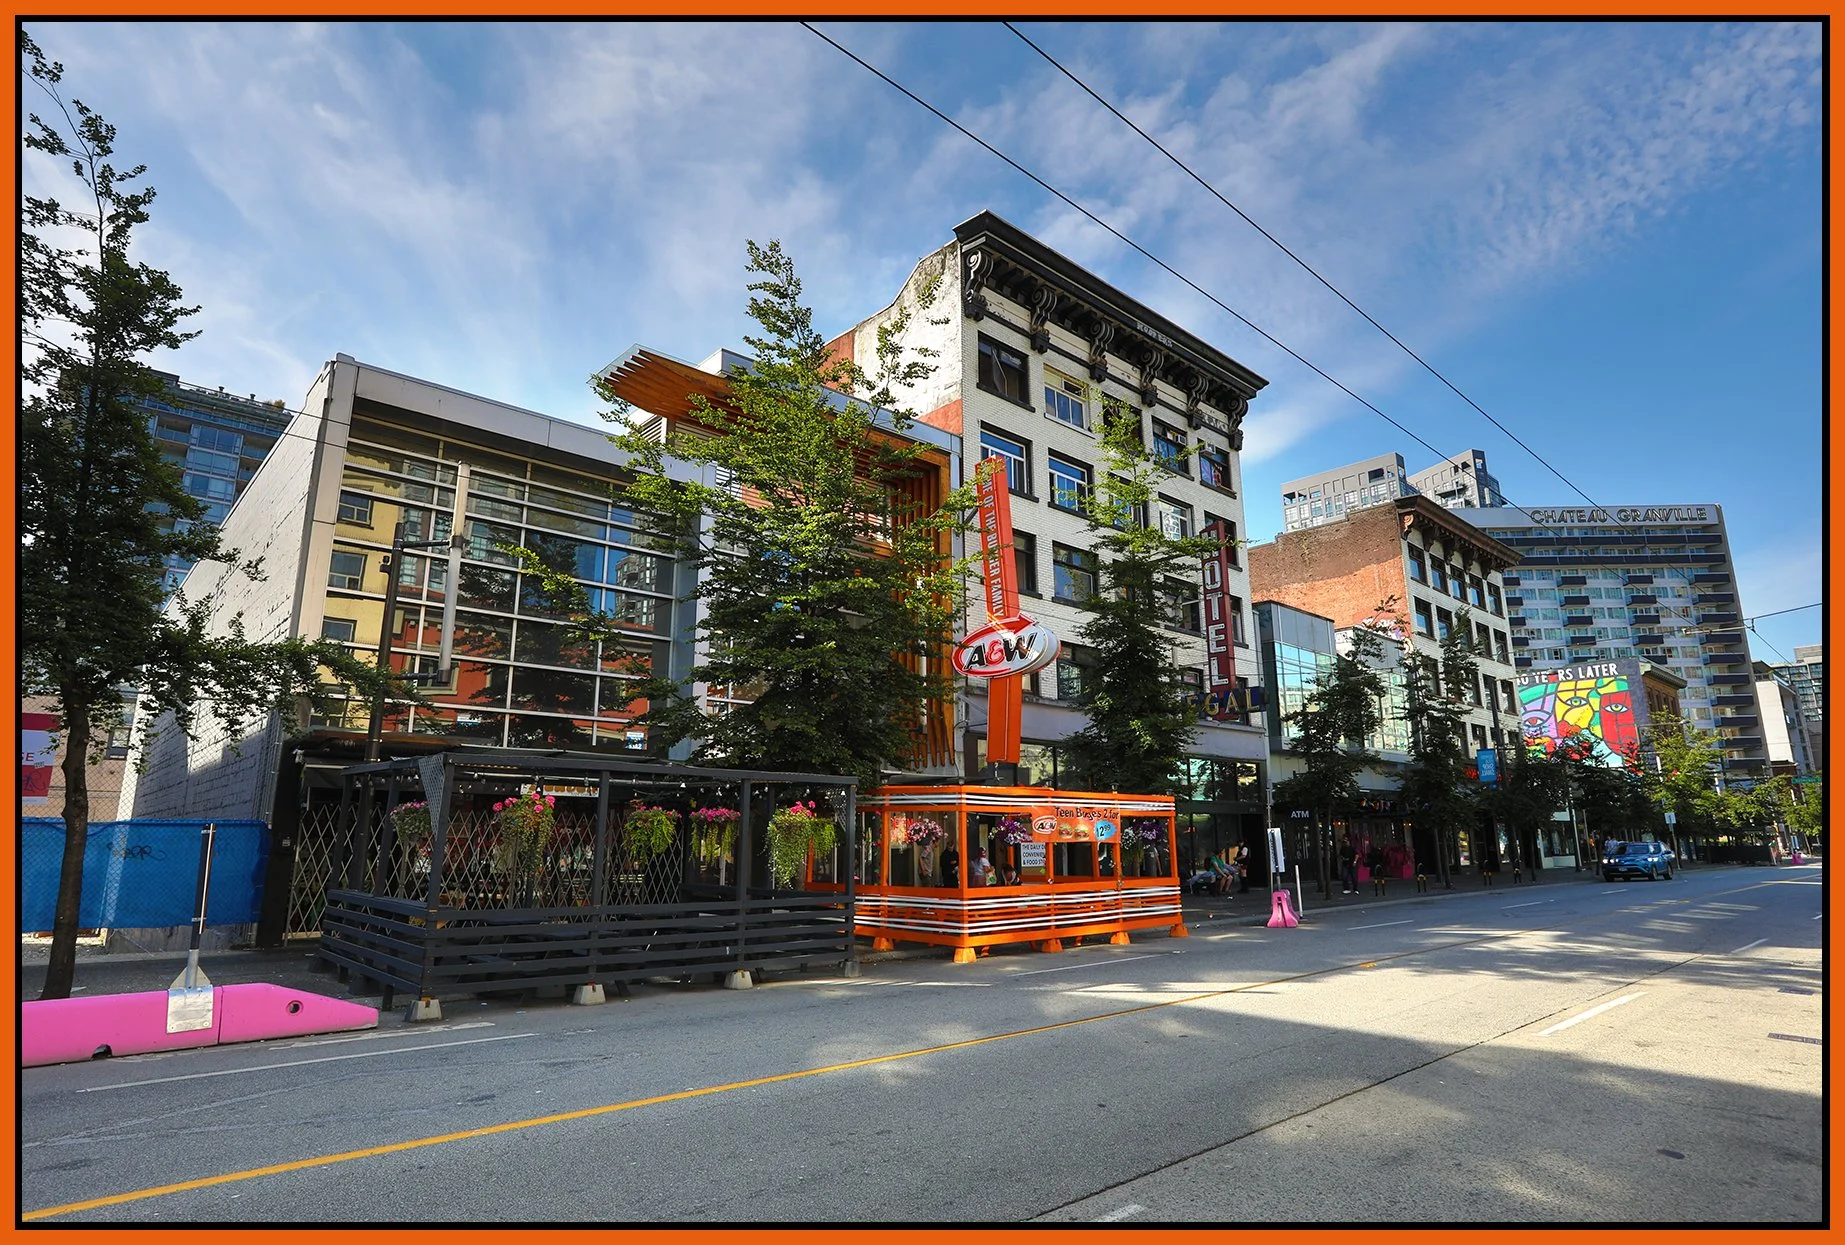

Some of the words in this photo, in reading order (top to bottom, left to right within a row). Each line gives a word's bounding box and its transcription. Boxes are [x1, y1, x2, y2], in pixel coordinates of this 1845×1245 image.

[983, 496, 995, 508] OF
[985, 510, 997, 531] THE
[1531, 509, 1608, 524] CHATEAU
[1616, 507, 1707, 523] GRANVILLE
[990, 578, 1005, 616] FAMILY
[1202, 529, 1229, 687] HOTEL
[962, 632, 1038, 671] A&W
[1532, 668, 1574, 684] YERS
[1578, 663, 1619, 678] LATER
[1187, 688, 1260, 716] EGAL
[1055, 807, 1074, 817] Teen
[1103, 808, 1109, 819] 2
[1109, 809, 1120, 820] for
[1290, 810, 1310, 819] ATM
